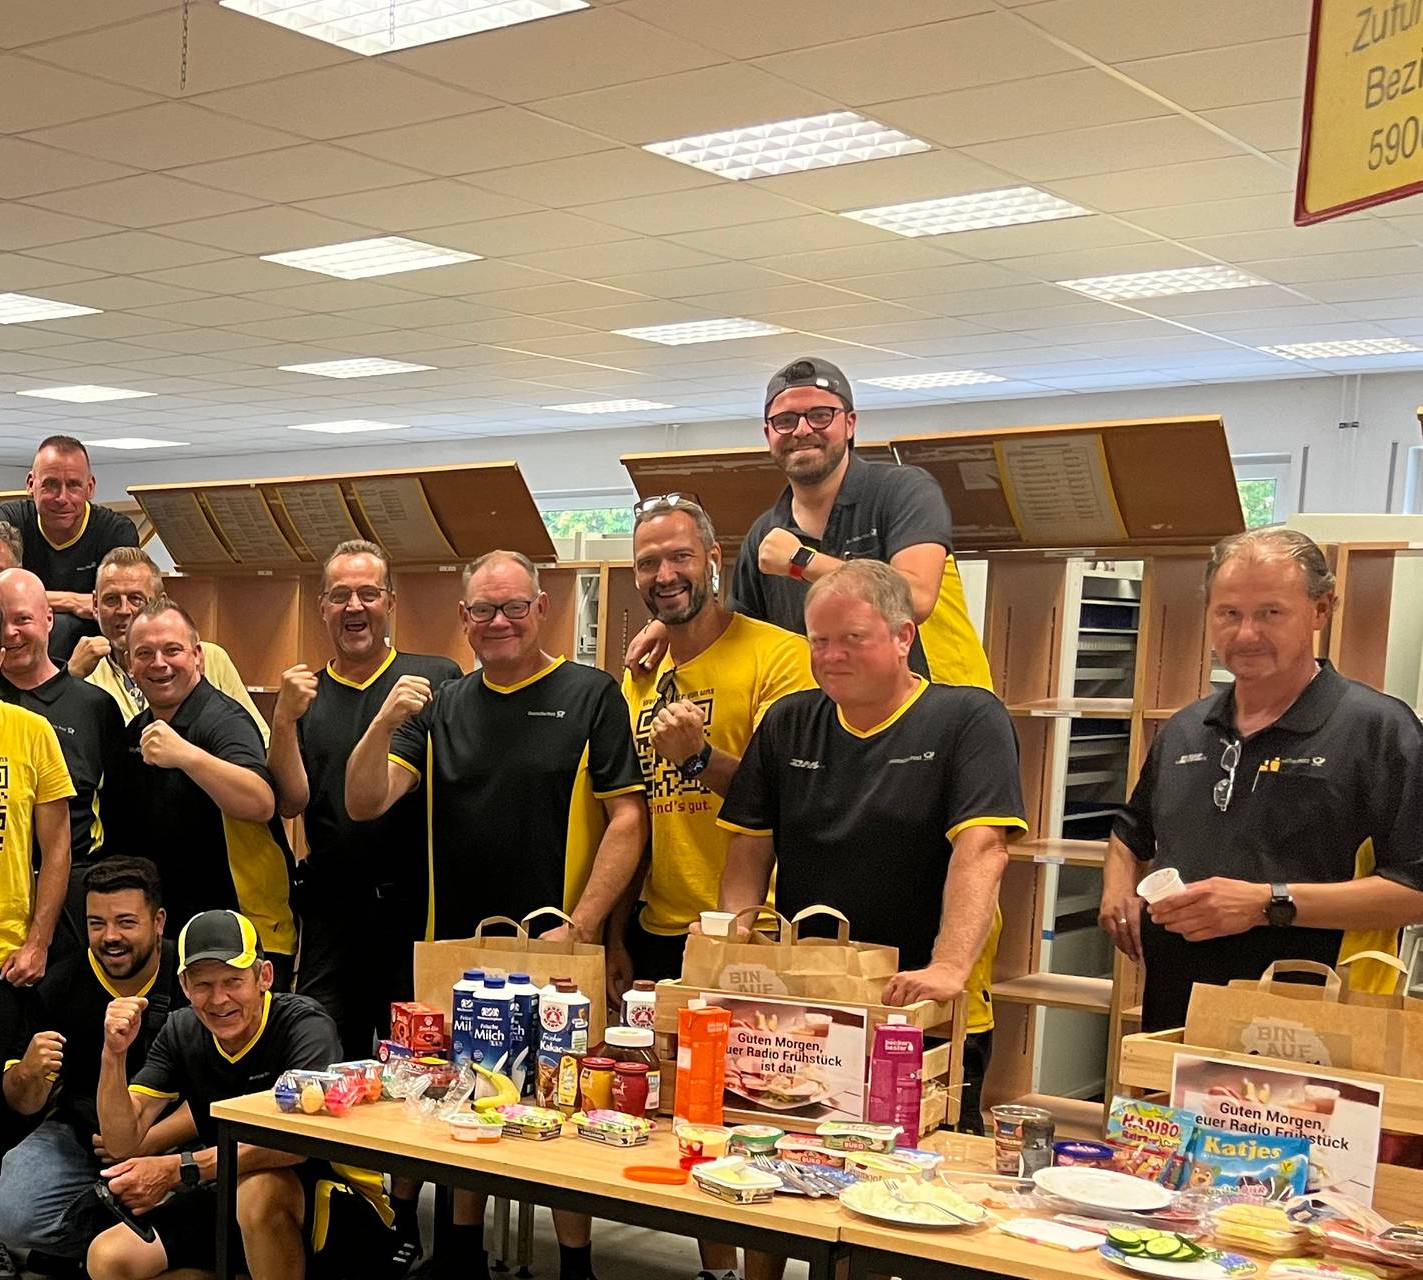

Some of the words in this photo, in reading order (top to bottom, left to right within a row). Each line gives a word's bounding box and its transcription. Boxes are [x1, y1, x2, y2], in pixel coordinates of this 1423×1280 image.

[1368, 115, 1423, 170] 590
[648, 800, 686, 815] ind's
[688, 800, 712, 814] gut.
[729, 970, 762, 985] BIN
[454, 1020, 472, 1031] Mil
[1257, 1026, 1296, 1042] BIN
[474, 1029, 505, 1041] Milch
[737, 1032, 772, 1047] Guten
[775, 1036, 823, 1055] Morgen,
[725, 1047, 743, 1056] uer
[746, 1046, 780, 1060] Radio
[782, 1050, 842, 1067] Frühstück
[1267, 1043, 1312, 1059] AUF
[760, 1060, 776, 1072] ist
[778, 1062, 797, 1075] da!
[1121, 1113, 1179, 1138] HARIBO
[1195, 1115, 1226, 1129] euer
[1230, 1118, 1271, 1136] Radio
[1219, 1102, 1262, 1119] Guten
[1265, 1109, 1326, 1133] Morgen,
[1202, 1135, 1282, 1161] Katjes
